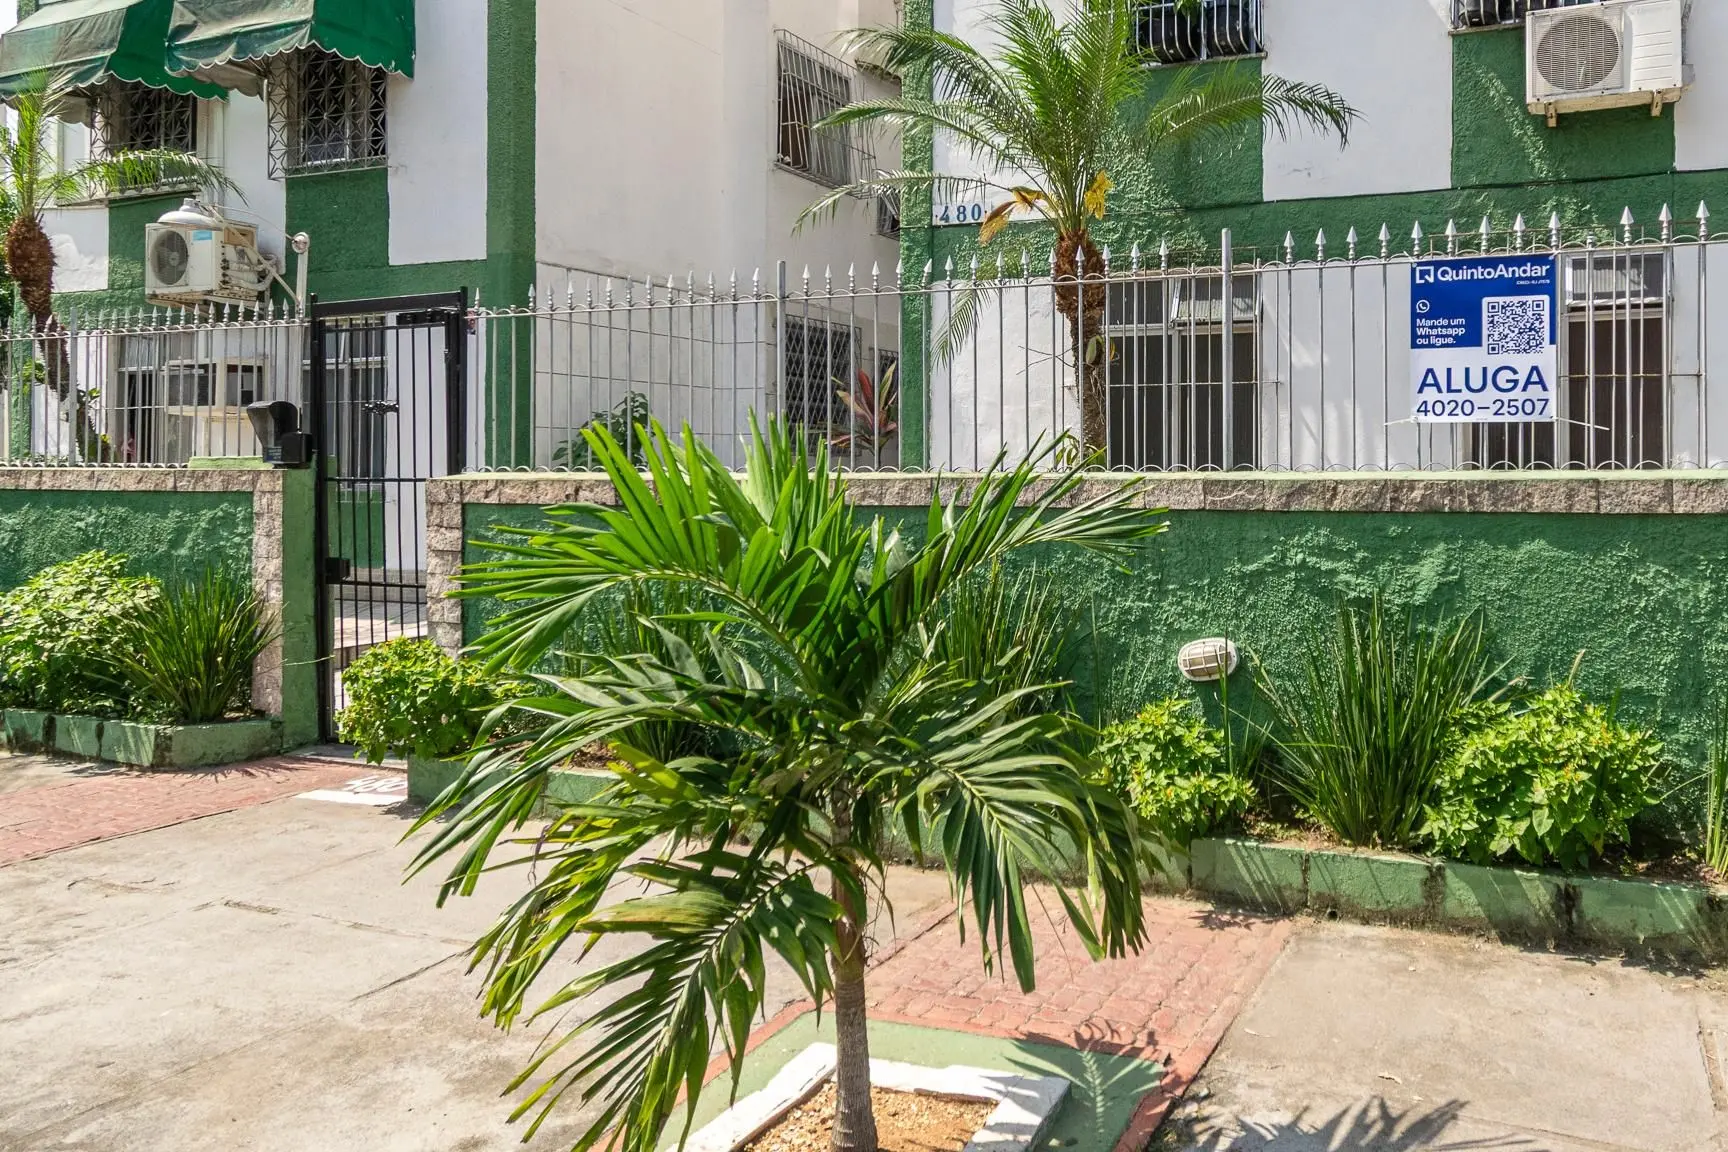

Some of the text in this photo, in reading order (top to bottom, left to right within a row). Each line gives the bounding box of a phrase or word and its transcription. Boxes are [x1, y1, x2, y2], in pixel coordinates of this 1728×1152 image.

[939, 203, 982, 223] 480
[1437, 262, 1550, 281] QuintoAndar
[1416, 317, 1465, 326] Mande um
[1416, 327, 1465, 336] Whatsapp
[1430, 335, 1456, 346] ligue.
[1417, 365, 1549, 394] ALUGA
[1416, 398, 1550, 417] 4020-2507
